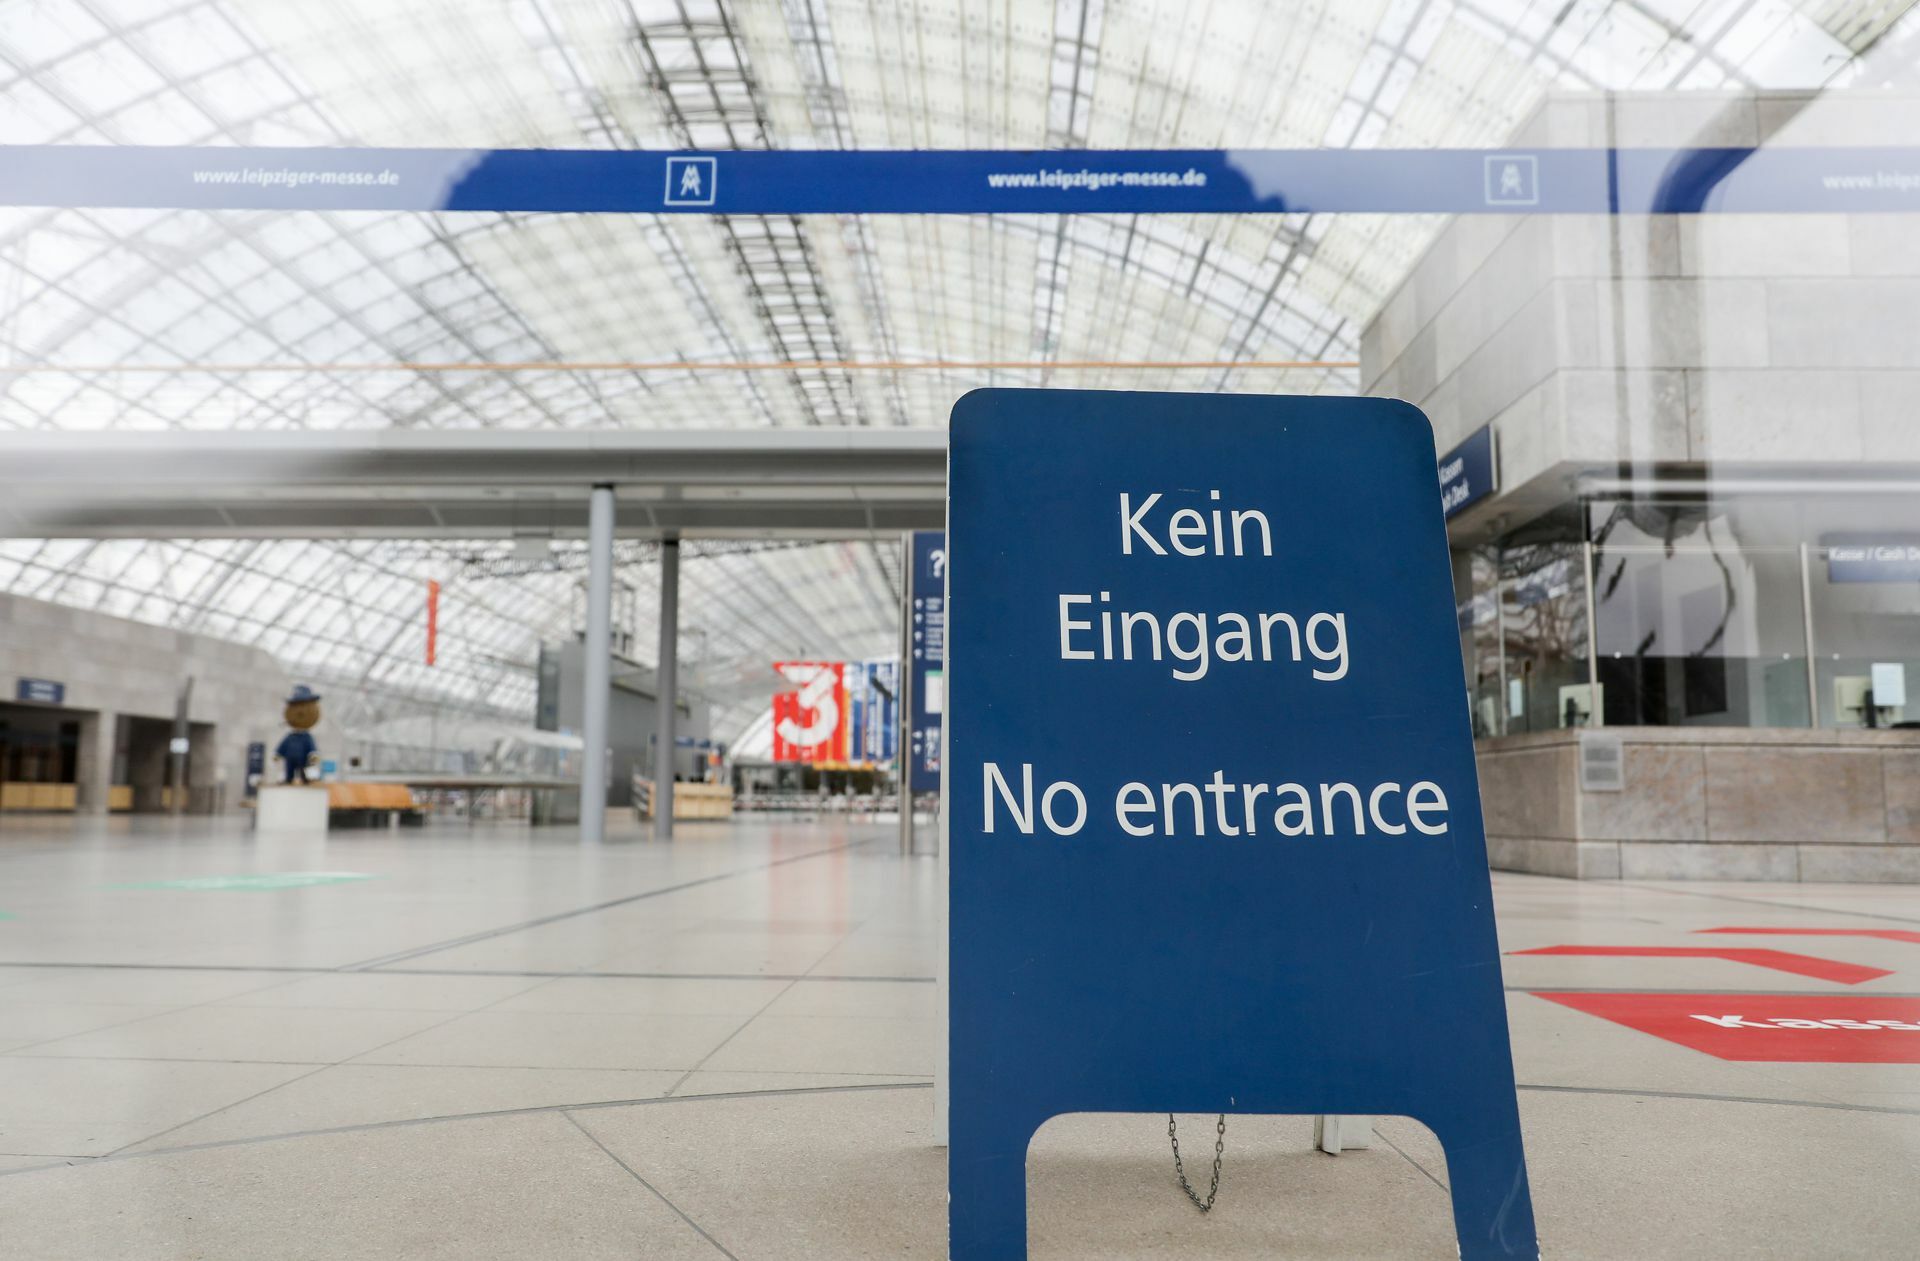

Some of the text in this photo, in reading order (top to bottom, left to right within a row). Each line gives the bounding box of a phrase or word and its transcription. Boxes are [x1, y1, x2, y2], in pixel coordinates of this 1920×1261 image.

[193, 168, 399, 188] www.leipziger-messe.de
[988, 168, 1206, 190] www.leipziger-messe.de
[1118, 488, 1274, 557] Kein
[1058, 590, 1351, 682] Eingang
[981, 761, 1450, 837] No entrance
[1688, 1013, 1920, 1031] Kass
